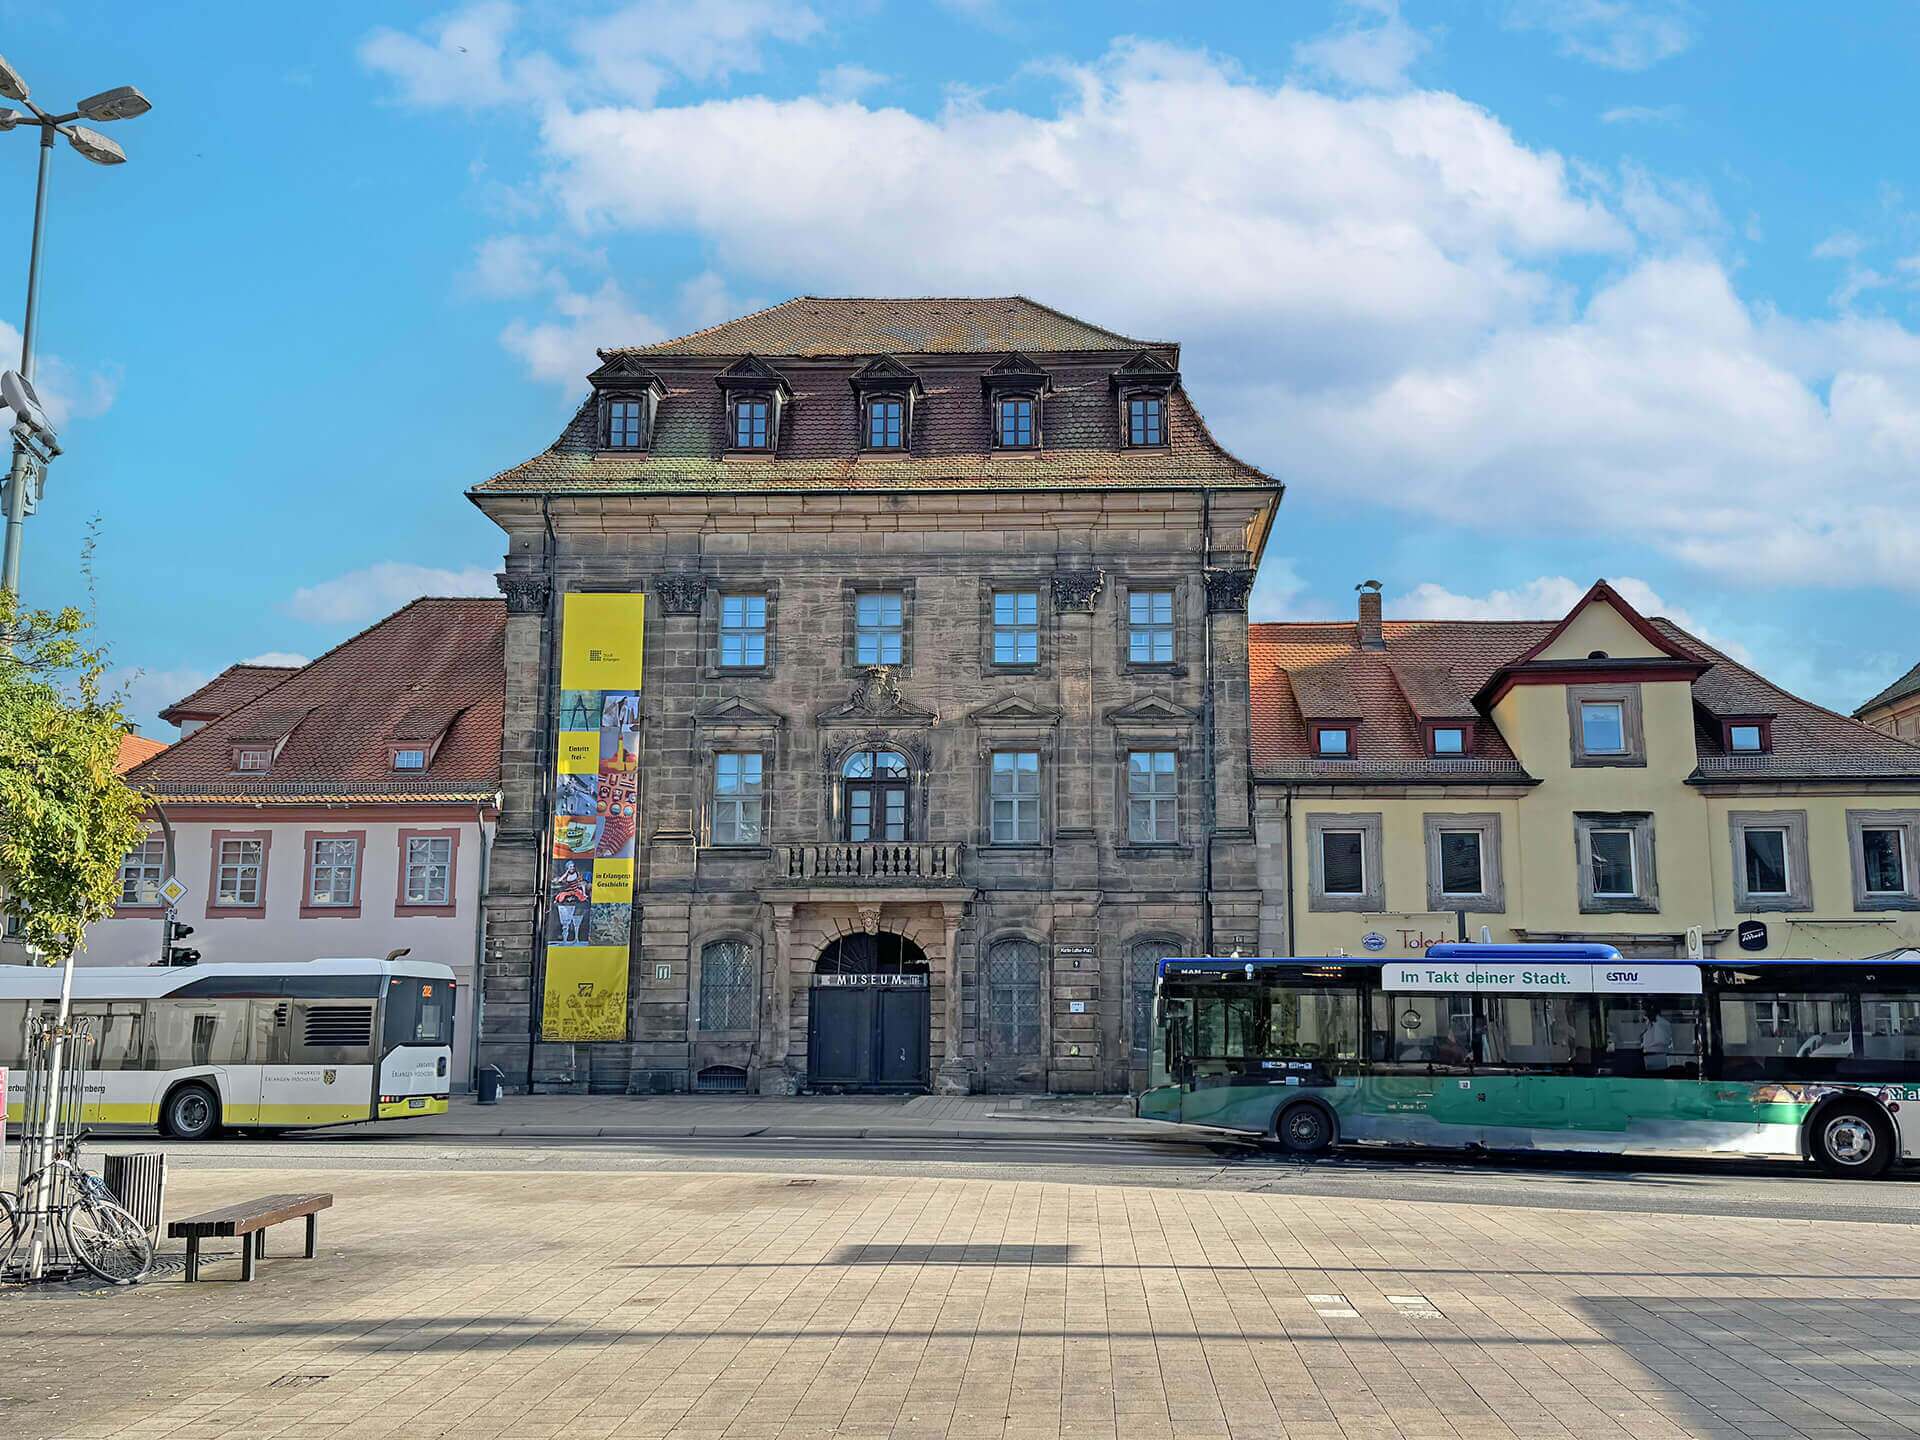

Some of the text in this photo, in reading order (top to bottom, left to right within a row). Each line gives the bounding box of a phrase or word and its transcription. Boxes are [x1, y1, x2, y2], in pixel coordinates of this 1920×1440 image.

[837, 974, 901, 985] MUSEUM
[1400, 970, 1571, 985] Im Takt deiner Stadt.
[422, 984, 432, 998] 202
